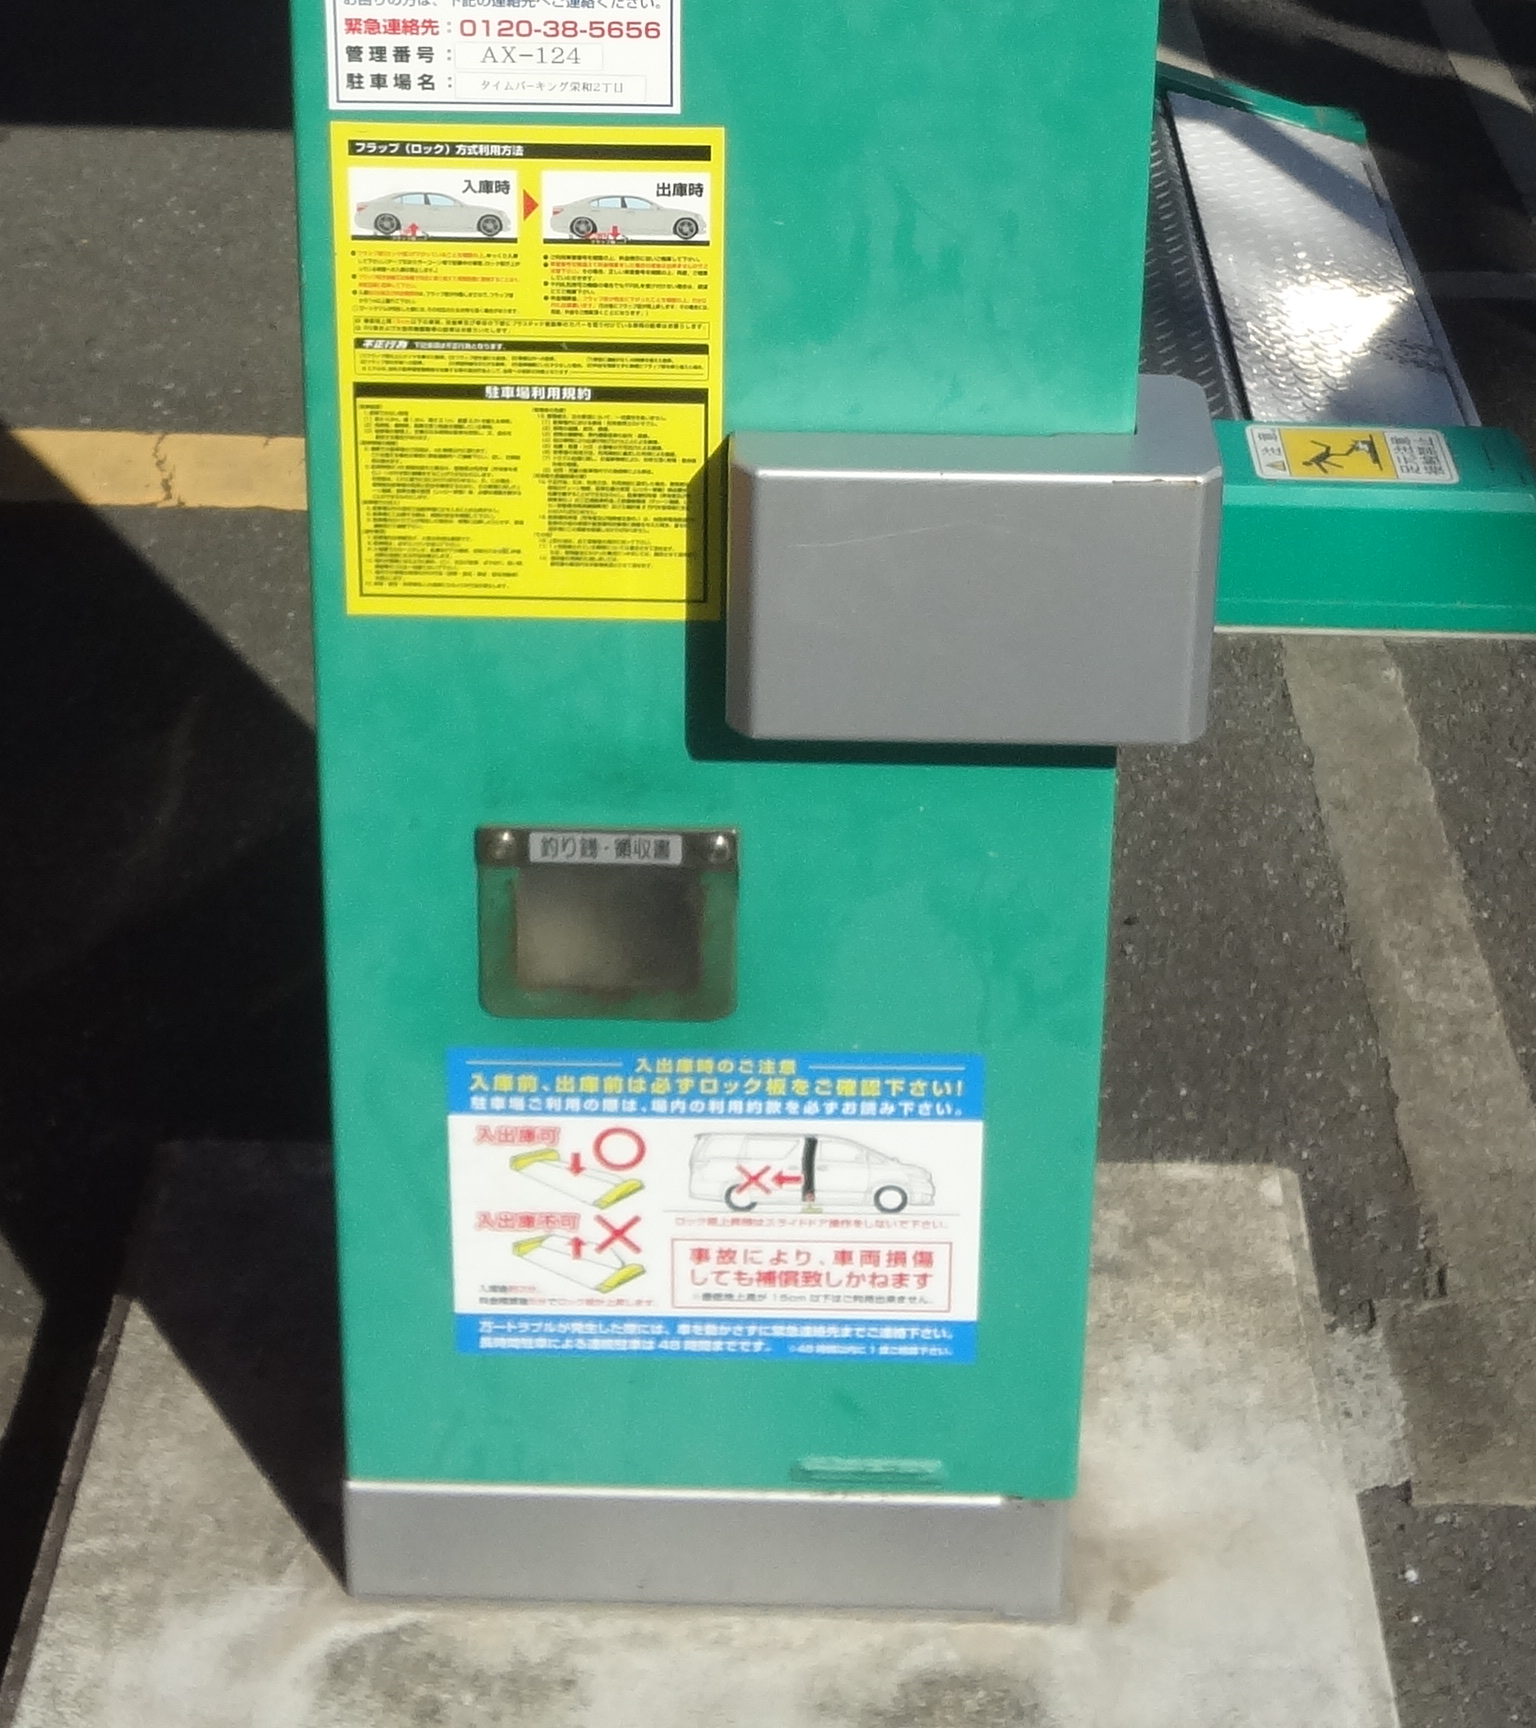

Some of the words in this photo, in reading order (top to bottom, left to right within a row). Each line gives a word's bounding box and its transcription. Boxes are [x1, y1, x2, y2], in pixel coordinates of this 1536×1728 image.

[460, 19, 661, 40] 0120-38-5656
[480, 46, 581, 65] AX-124
[462, 179, 511, 195] 入庫時
[656, 182, 704, 198] 出庫時
[485, 385, 591, 401] 駐車場利用規約
[475, 1125, 561, 1145] 入出庫可
[476, 1211, 581, 1232] 入出庫不可
[689, 1246, 935, 1268] 事故により、車両損傷
[690, 1268, 934, 1290] しても補償致しかねます
